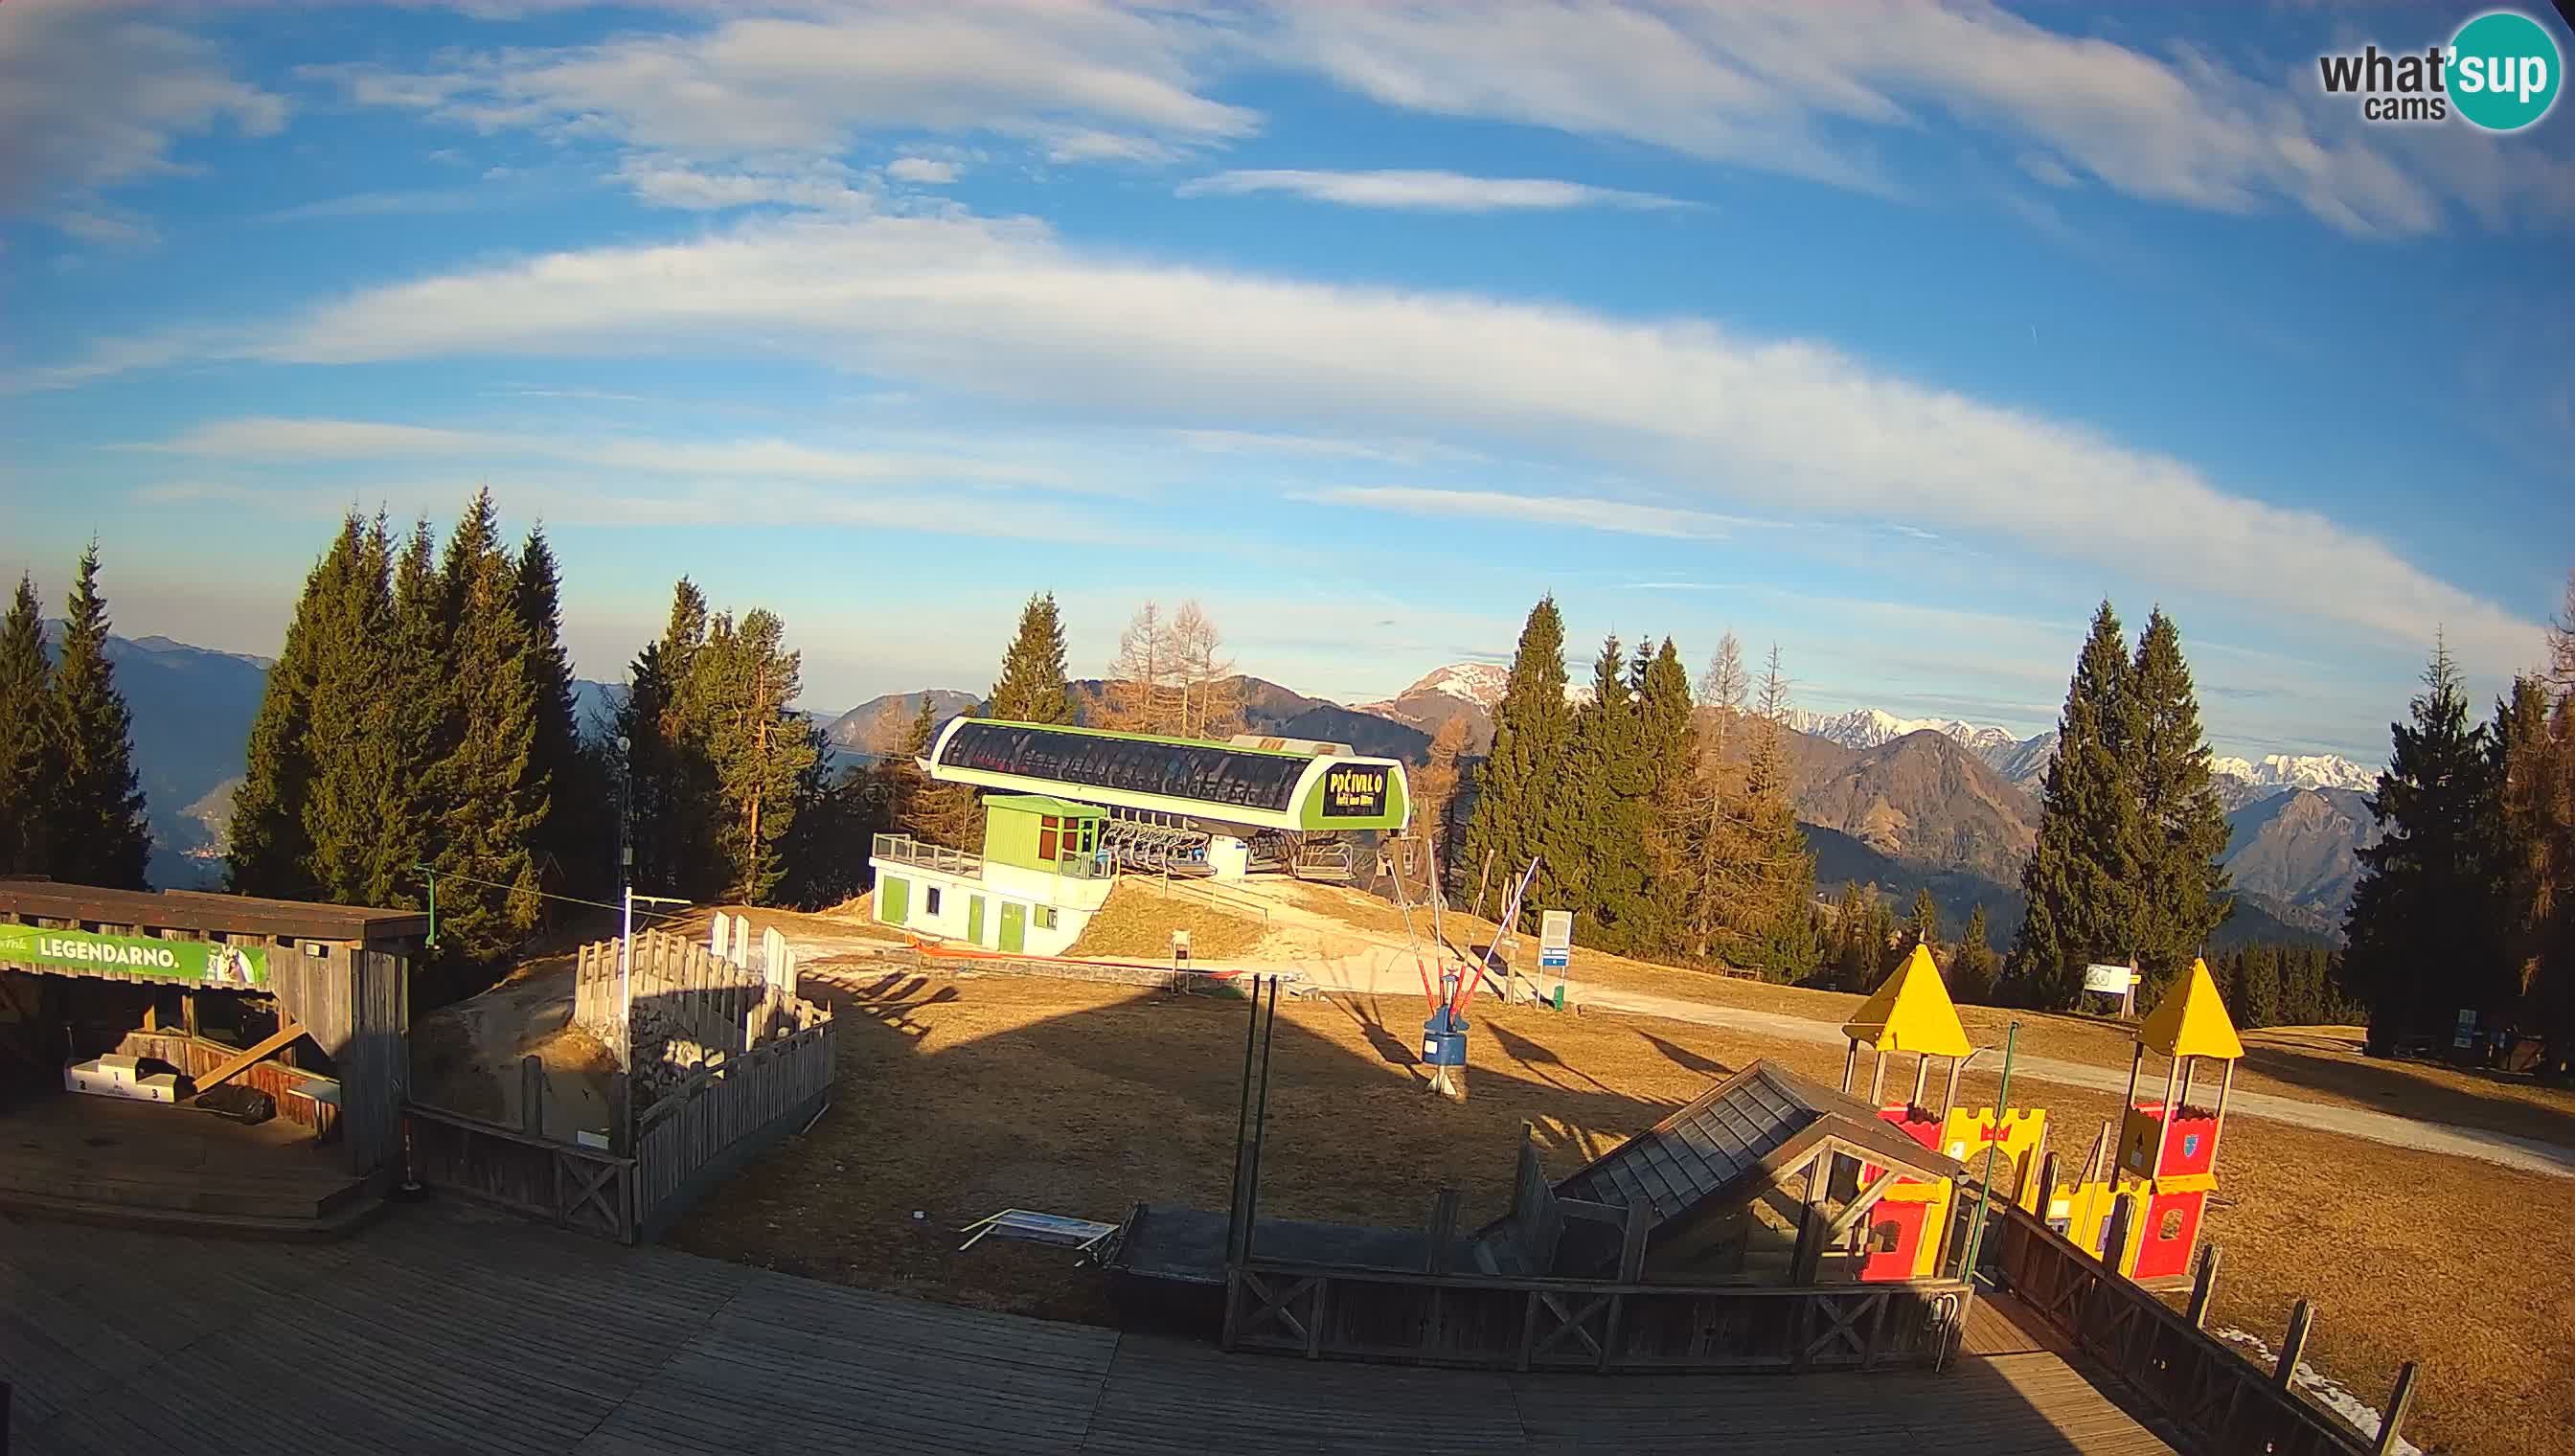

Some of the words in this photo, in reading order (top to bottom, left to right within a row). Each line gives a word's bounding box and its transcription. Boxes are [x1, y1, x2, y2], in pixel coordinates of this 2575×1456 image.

[1330, 769, 1382, 793] POČIVALO
[39, 937, 180, 968] LEGENDARNO.
[114, 1071, 119, 1081] 1
[80, 1080, 86, 1090] 2
[151, 1088, 158, 1099] 3
